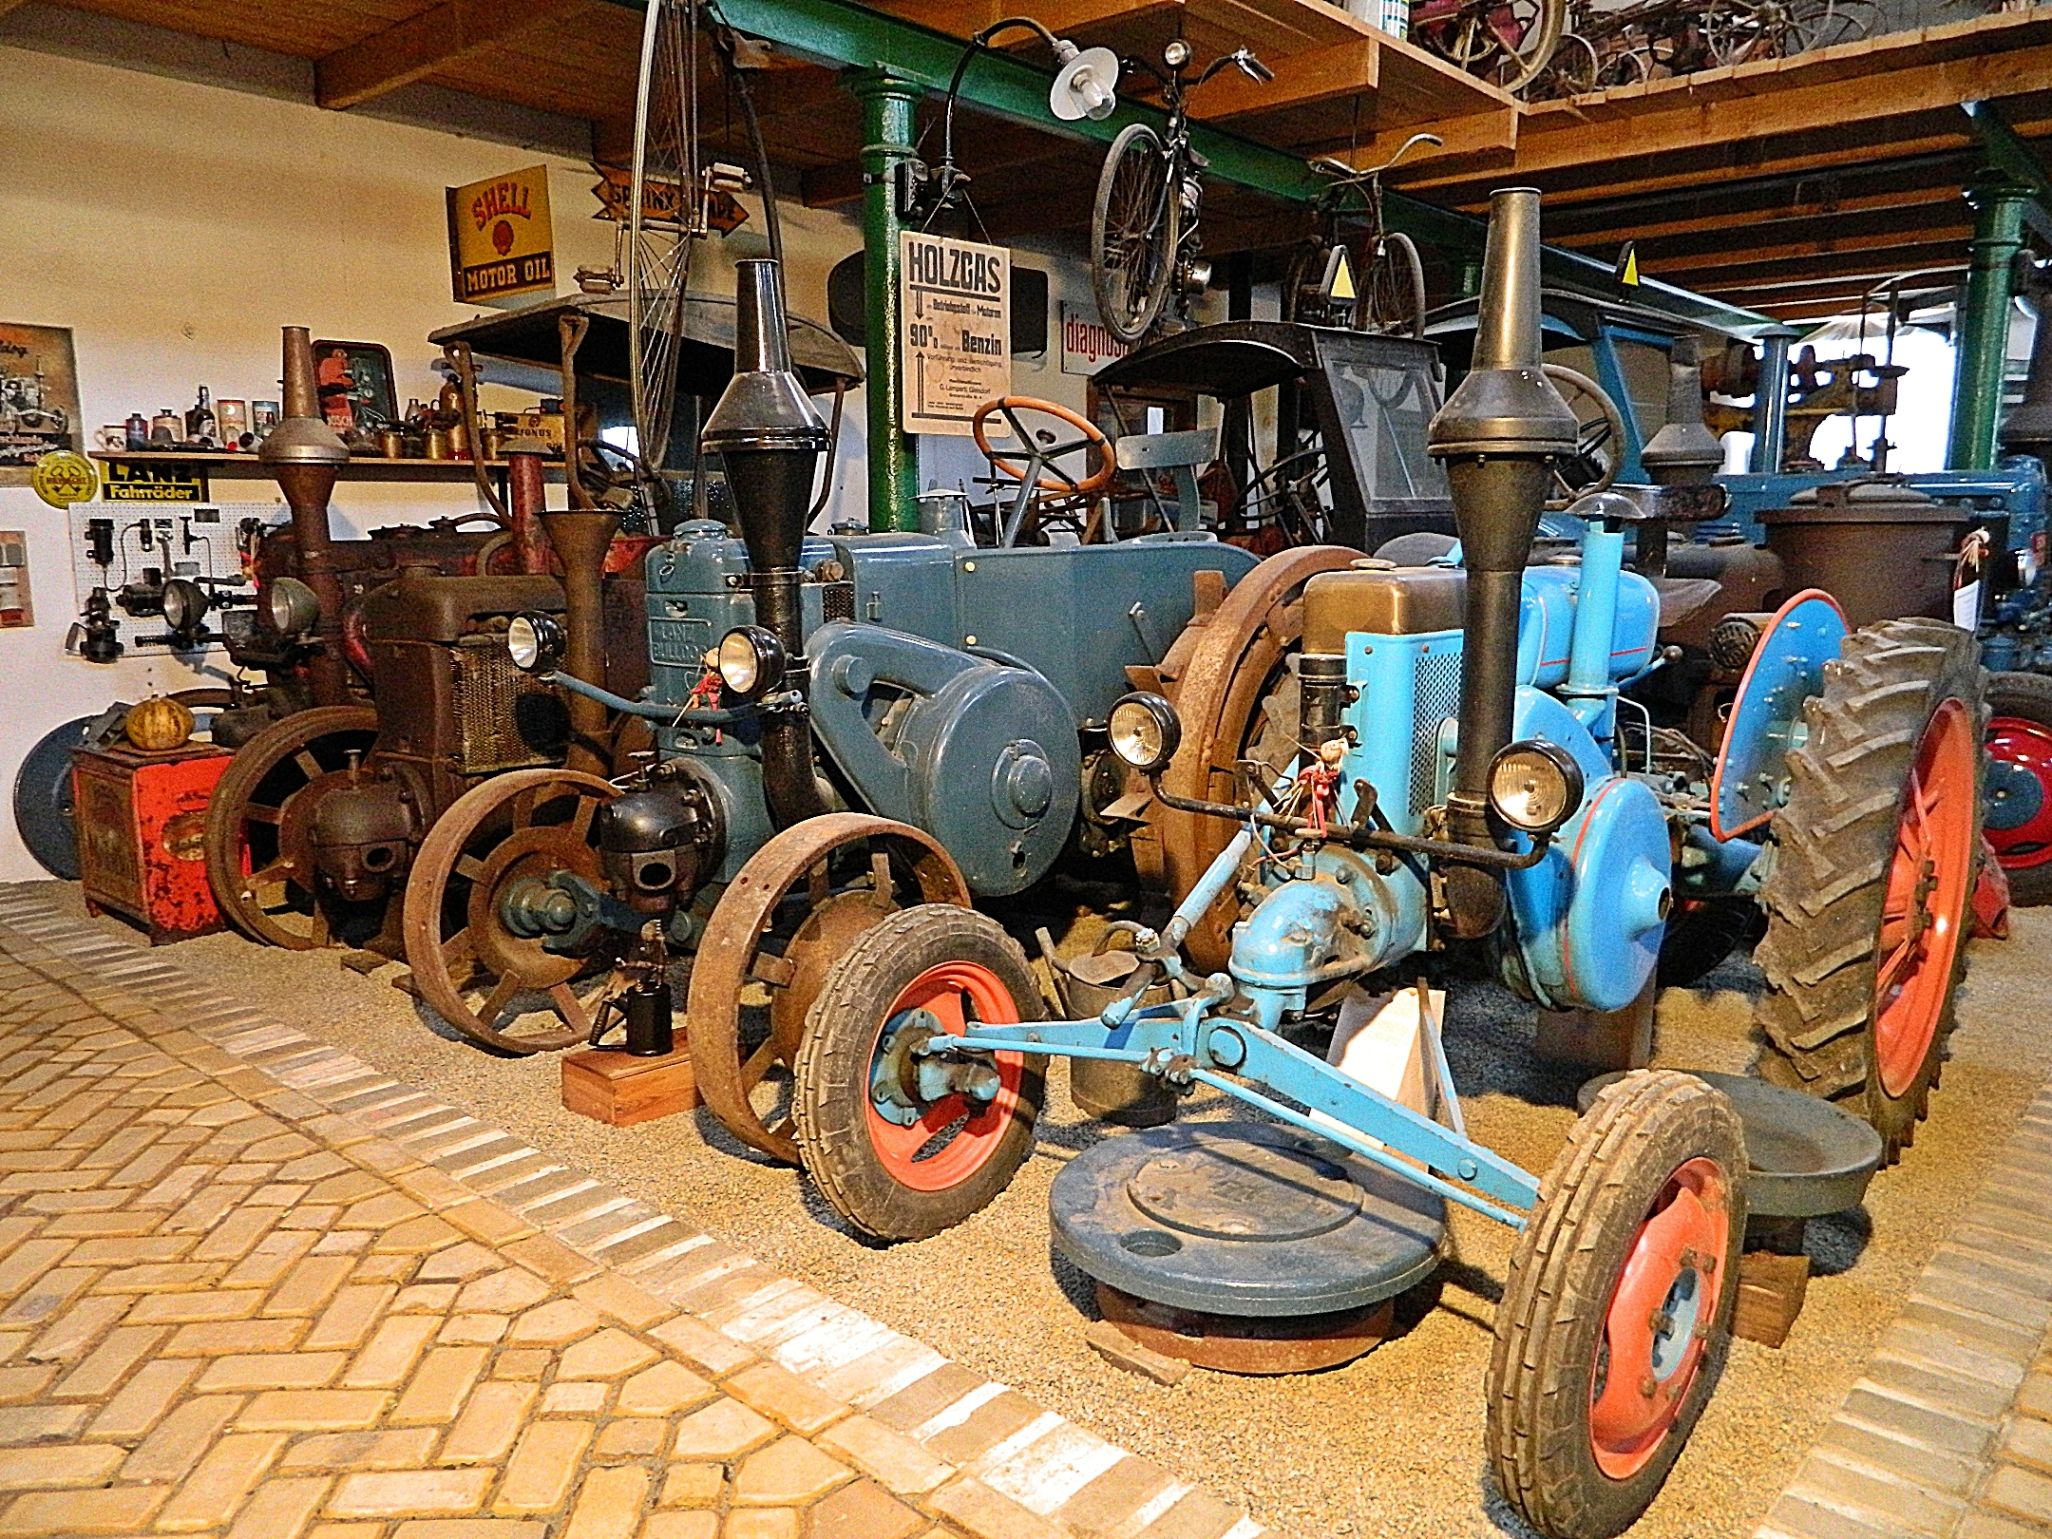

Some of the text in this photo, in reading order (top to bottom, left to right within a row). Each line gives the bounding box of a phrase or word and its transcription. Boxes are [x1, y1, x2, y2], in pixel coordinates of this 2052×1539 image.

[471, 182, 531, 231] SHELL
[467, 257, 551, 292] MOTOR OIL
[909, 241, 1001, 293] HOLZGAS
[961, 330, 1002, 356] Benzin
[109, 463, 193, 483] LANZ
[110, 483, 193, 500] Fahrräder
